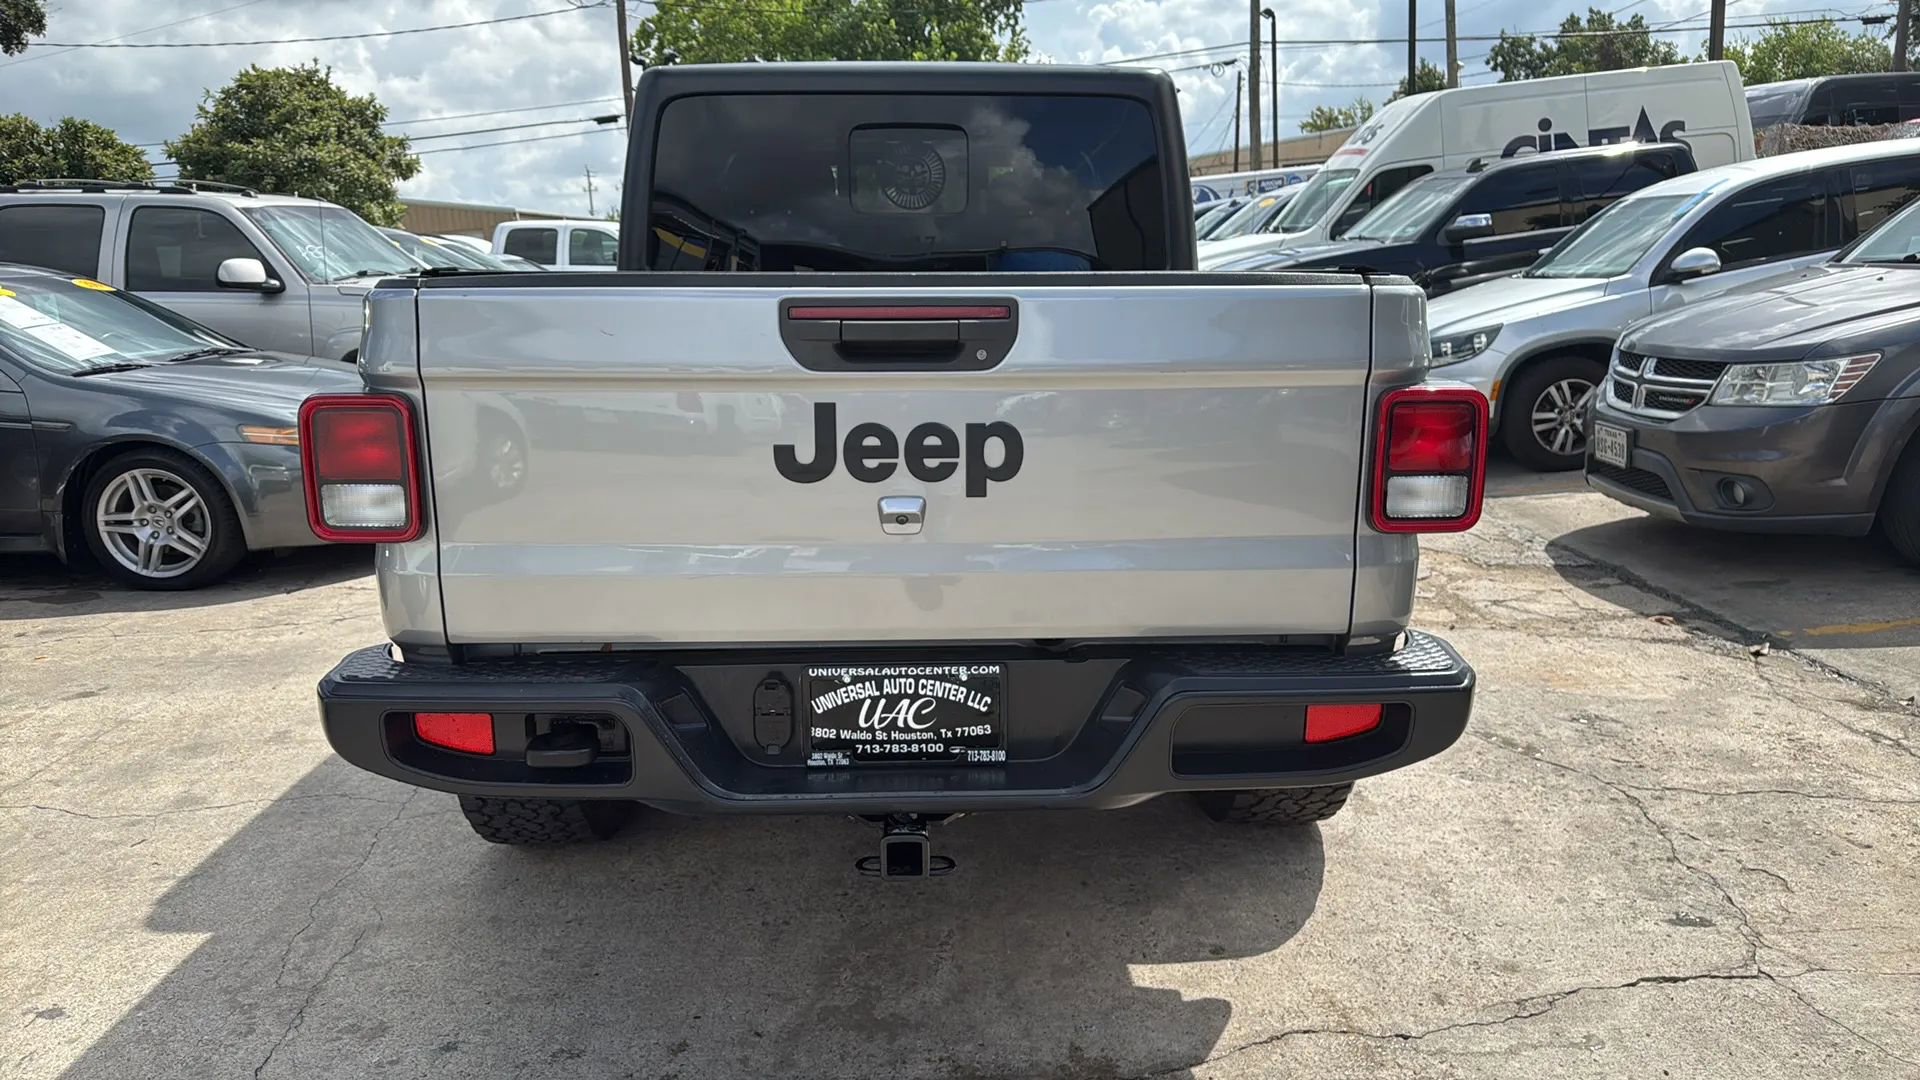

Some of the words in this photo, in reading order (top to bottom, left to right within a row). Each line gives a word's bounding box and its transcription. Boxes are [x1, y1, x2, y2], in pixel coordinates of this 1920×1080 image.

[773, 402, 1024, 497] Jeep
[808, 665, 1000, 676] UNIVERSALAUTOCENTER.COM
[811, 680, 880, 714] UNIVERSAL
[883, 678, 915, 695] AUTO
[918, 678, 967, 704] CENTER
[967, 690, 991, 712] LLC
[858, 697, 937, 729] UAC
[840, 729, 872, 740] Waldo
[875, 730, 888, 740] St
[891, 730, 937, 741] Houston,
[940, 729, 952, 738] Tx
[955, 725, 991, 737] 77063
[855, 743, 944, 754] 713-783-8100
[967, 750, 1006, 762] 713-783-8100
